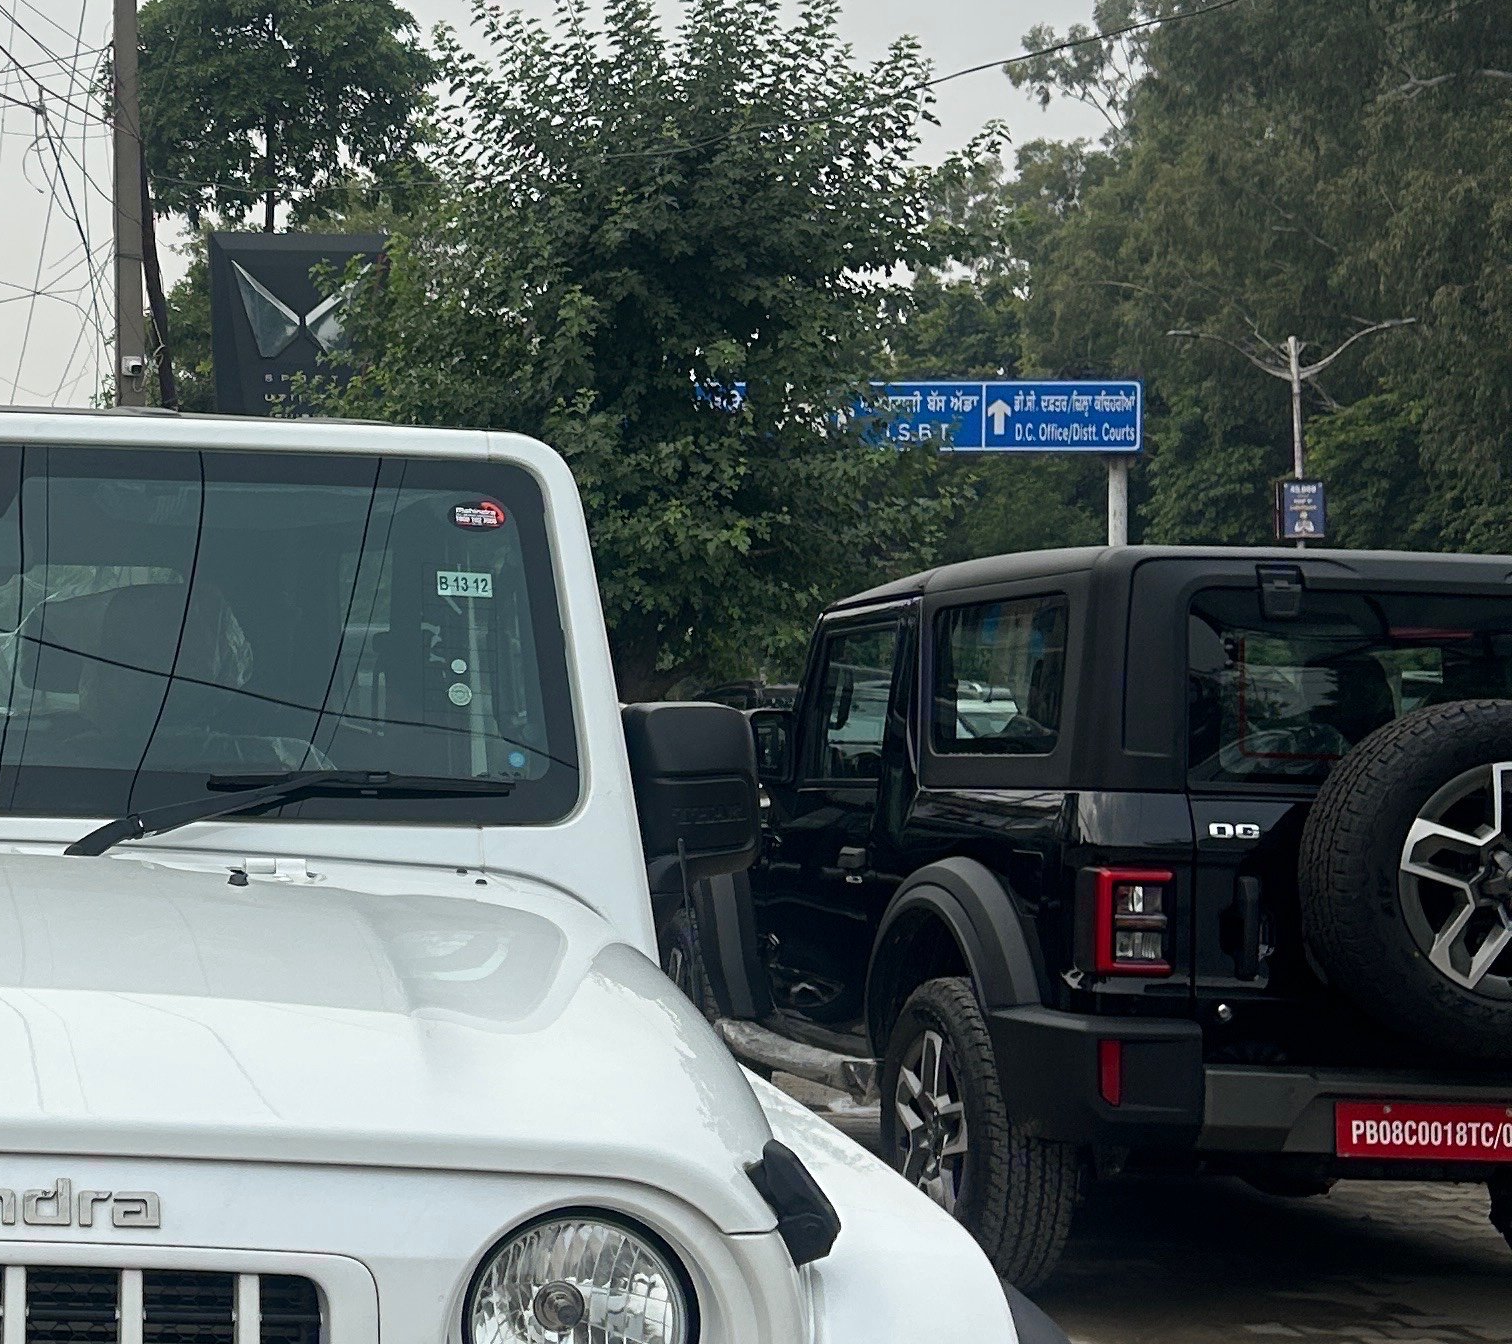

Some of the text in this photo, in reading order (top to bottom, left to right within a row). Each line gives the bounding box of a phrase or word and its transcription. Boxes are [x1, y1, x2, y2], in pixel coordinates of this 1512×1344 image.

[885, 423, 955, 441] I.S.BT.
[1014, 422, 1135, 444] D.C. Office/Distt. Courts
[439, 576, 488, 594] B 13 12
